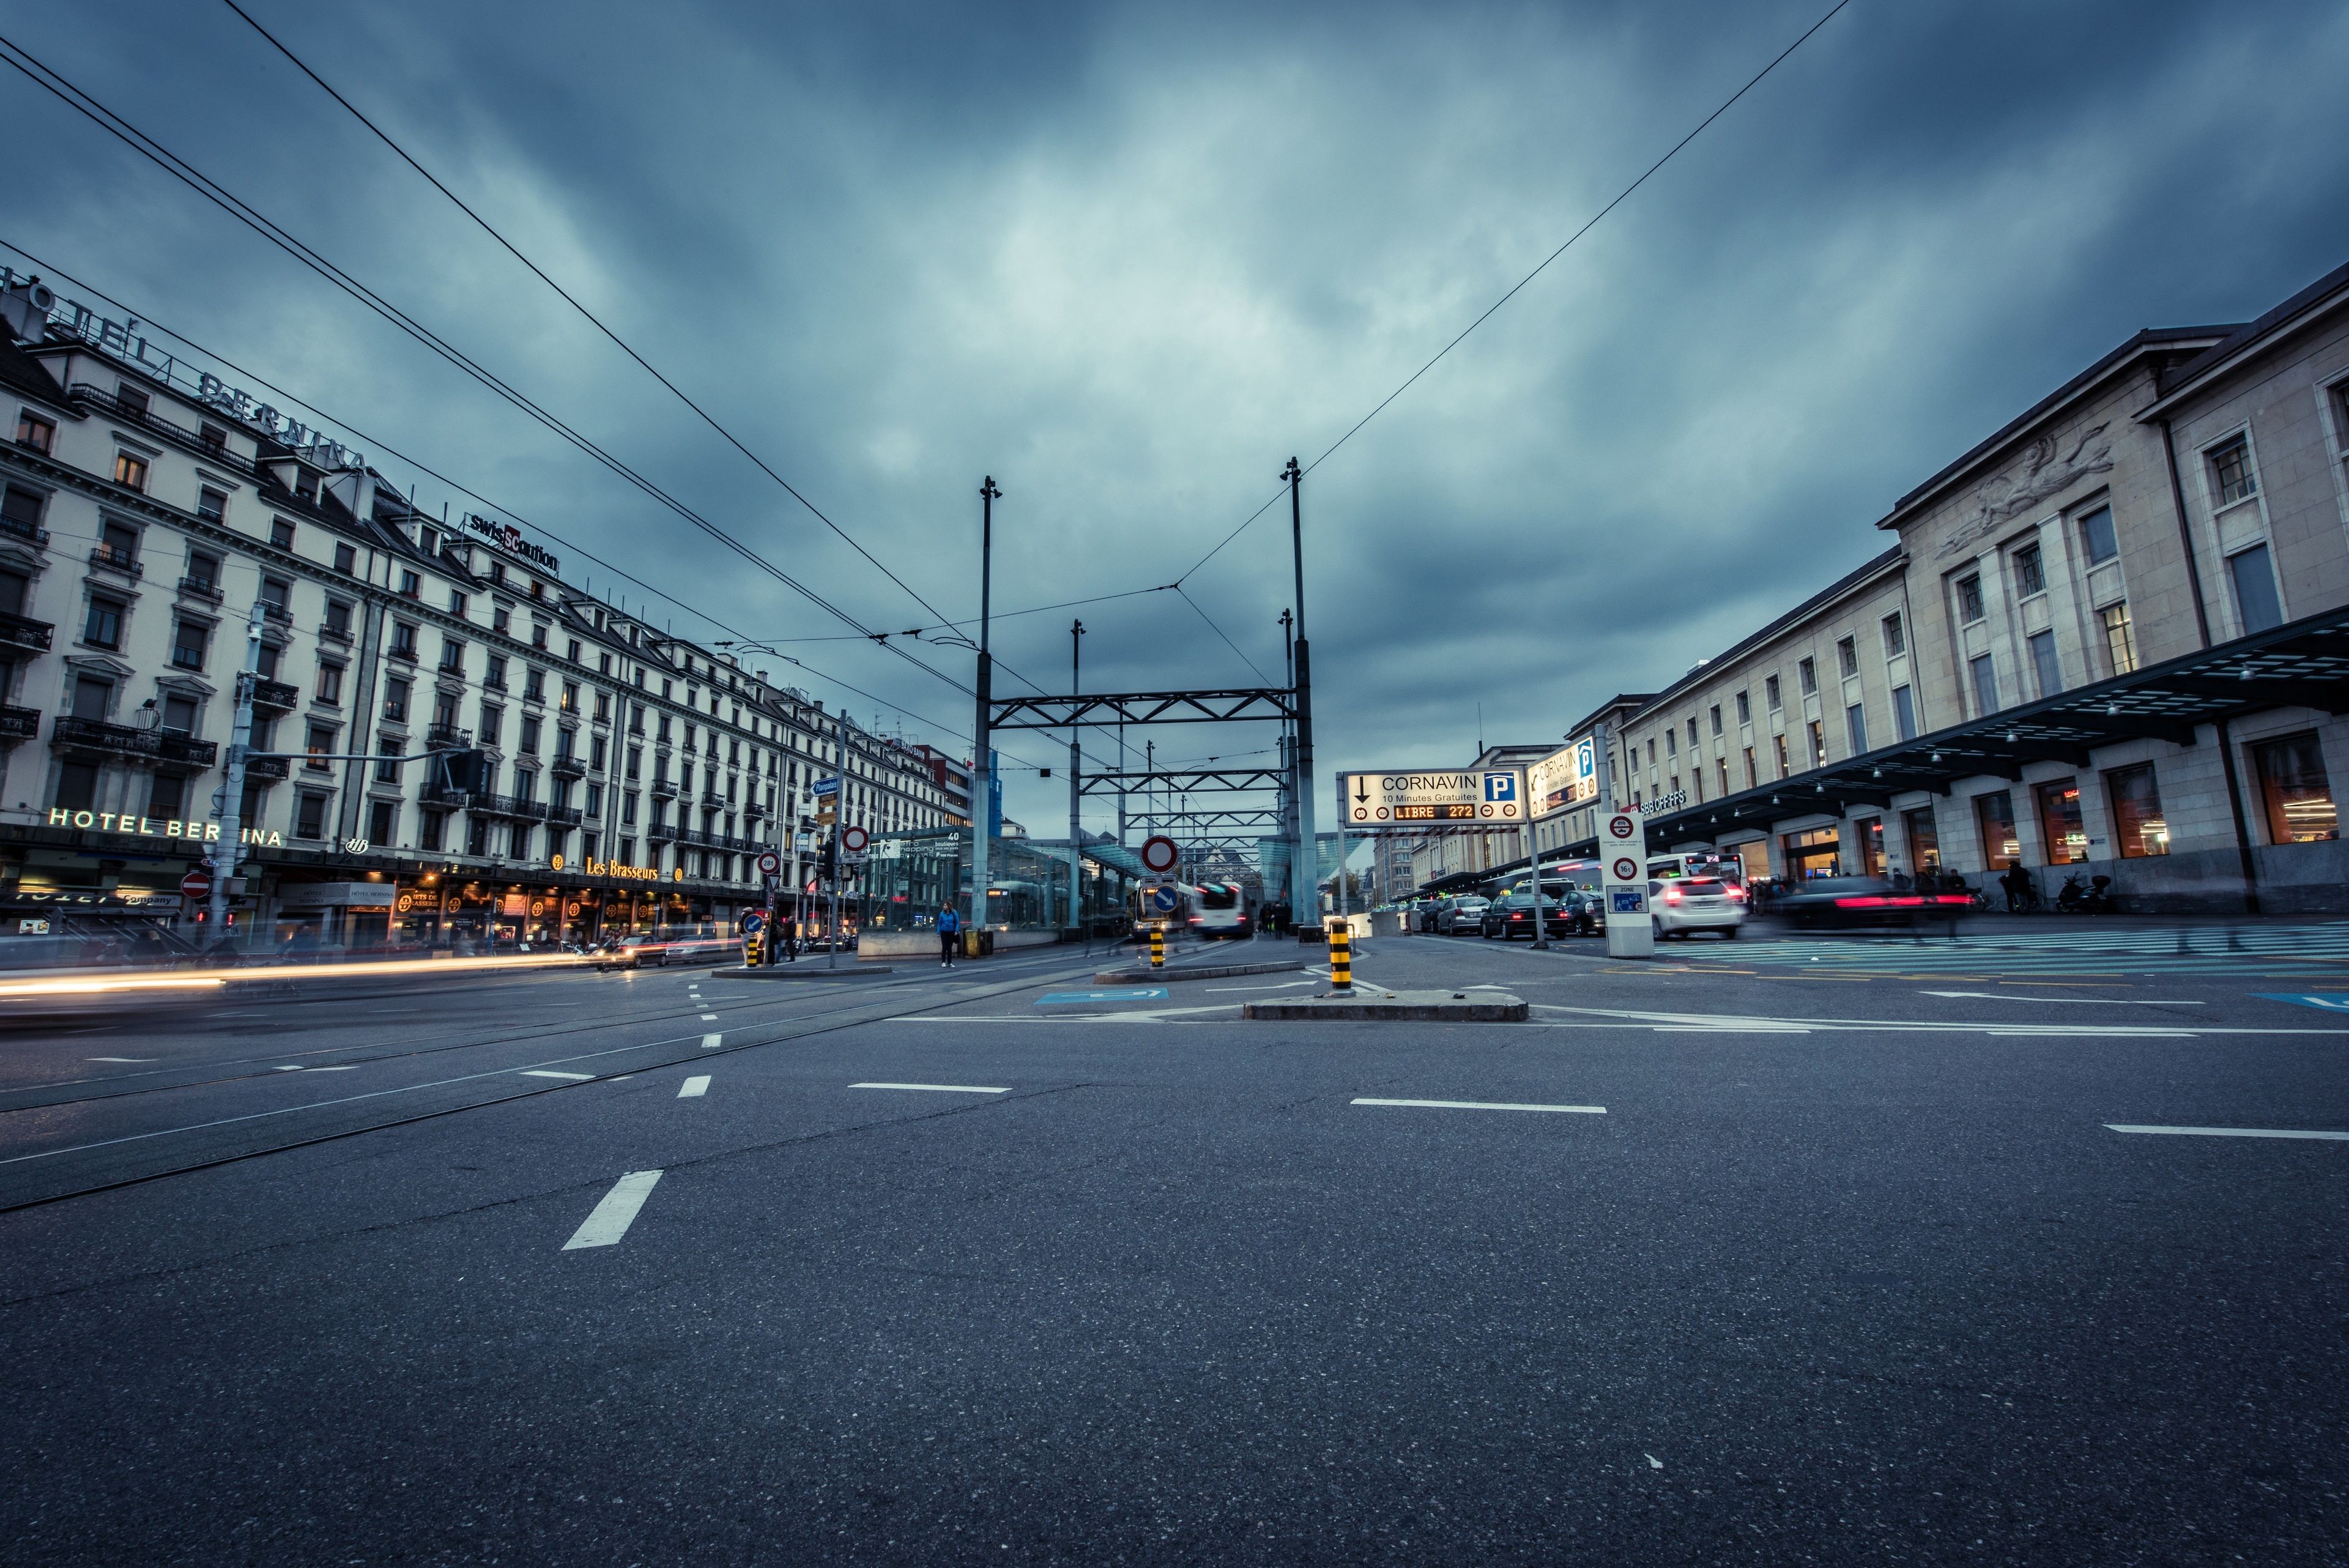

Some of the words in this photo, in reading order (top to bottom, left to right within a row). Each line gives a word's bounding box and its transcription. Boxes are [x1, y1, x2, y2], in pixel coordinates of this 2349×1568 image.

[201, 371, 368, 478] BERNINA
[1539, 749, 1576, 781] CORNAVIN
[815, 781, 837, 792] Plainpalais
[1382, 775, 1477, 791] CORNAVIN
[1493, 778, 1508, 800] P
[1396, 794, 1432, 803] Minutes
[1435, 793, 1478, 802] Gratuites
[1640, 800, 1654, 816] SBB
[1655, 795, 1669, 811] CFF
[1669, 789, 1685, 806] FFS
[1396, 807, 1434, 818] LIBRE
[1449, 806, 1473, 817] 272
[49, 807, 154, 835] HOTEL
[166, 820, 282, 847] BERINA
[948, 832, 959, 841] 40
[586, 856, 606, 875] Les
[609, 859, 658, 880] Brasseurs
[124, 895, 172, 905] Company
